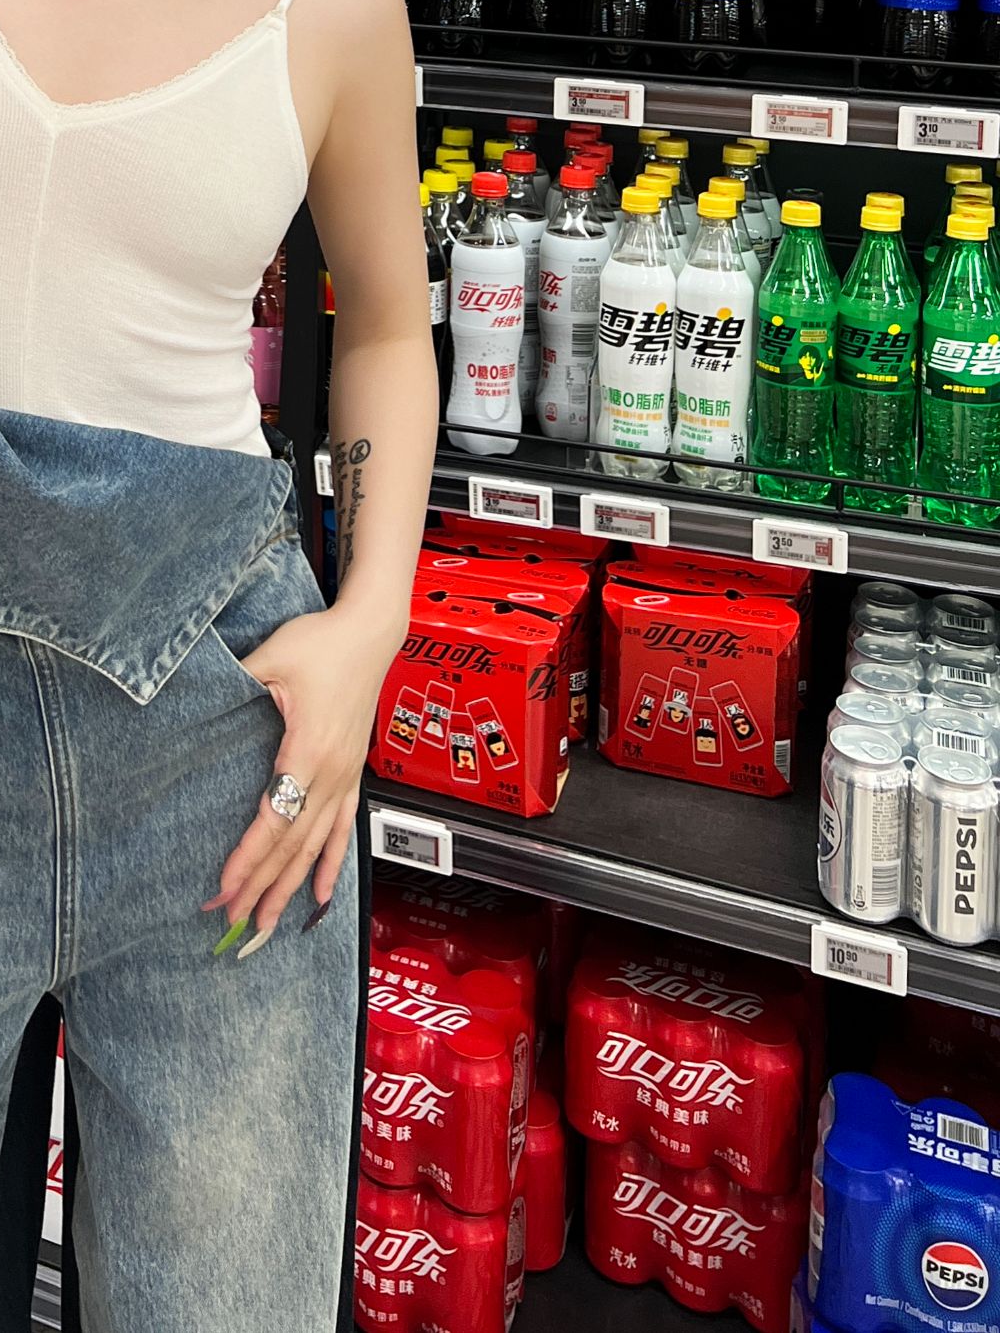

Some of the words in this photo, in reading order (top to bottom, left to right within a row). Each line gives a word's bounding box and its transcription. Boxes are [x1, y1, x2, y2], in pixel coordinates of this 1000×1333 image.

[457, 284, 525, 313] 可口可乐
[599, 302, 675, 354] 雪碧
[675, 306, 746, 359] 雪碧
[838, 323, 911, 364] 雪碧
[628, 352, 669, 367] 纤维+
[690, 356, 733, 373] 纤维+
[928, 336, 1000, 377] 雪碧
[401, 631, 506, 676] 可口可乐
[642, 621, 754, 660] 可口可乐
[952, 816, 978, 916] PEPSI
[604, 961, 766, 1025] 可口可乐
[596, 1030, 756, 1111] 可口可乐
[592, 1109, 621, 1133] 汽水
[636, 1087, 710, 1127] 经典美味
[612, 1171, 767, 1257] 可口可乐
[609, 1246, 638, 1269] 汽水
[651, 1227, 724, 1270] 经典美味
[925, 1258, 985, 1290] PEPSI
